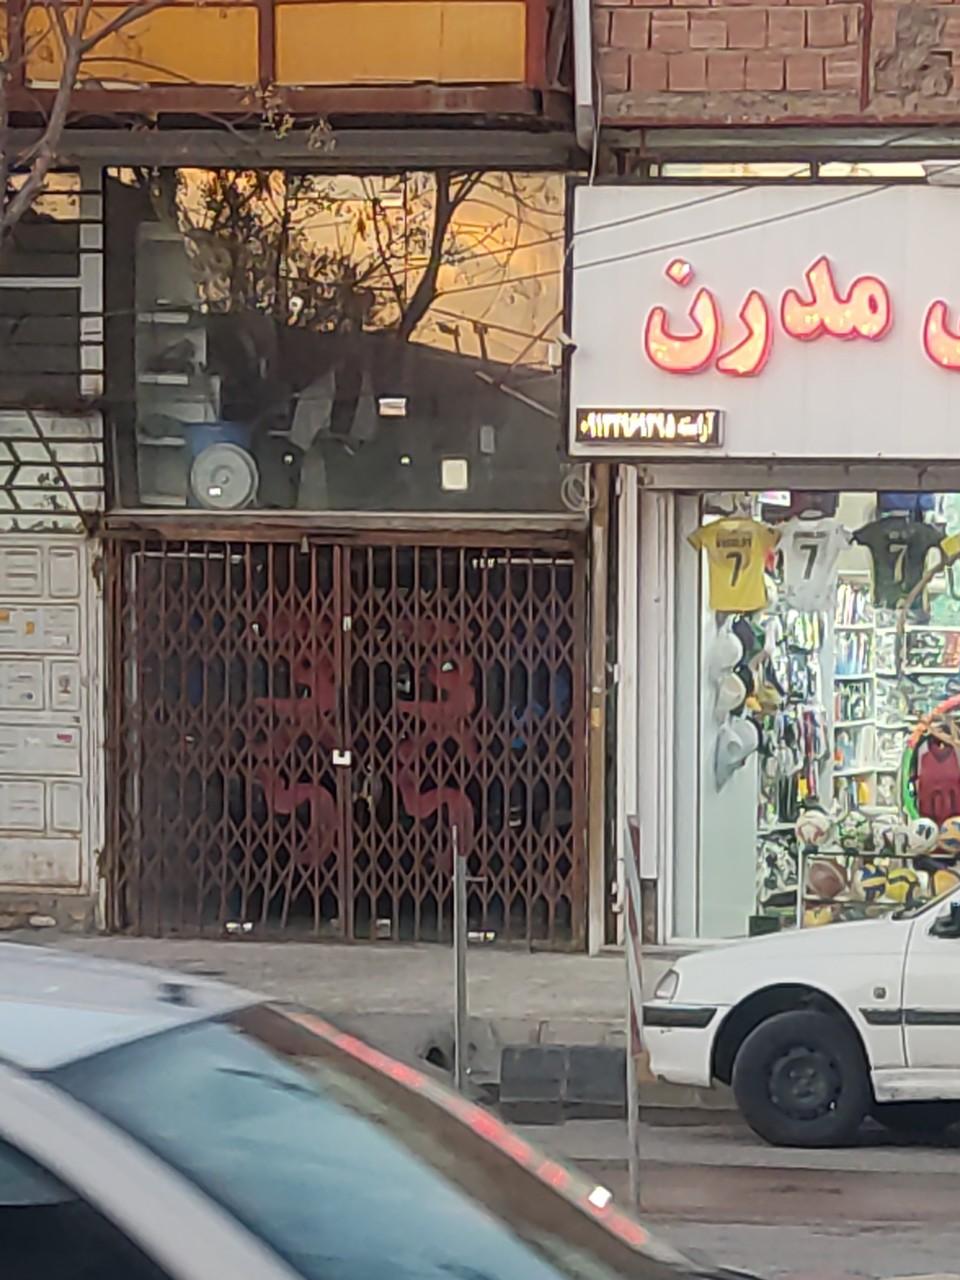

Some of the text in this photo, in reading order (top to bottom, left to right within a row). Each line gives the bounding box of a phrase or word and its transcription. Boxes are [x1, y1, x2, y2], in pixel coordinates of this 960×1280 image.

[644, 255, 893, 377] مدرن
[726, 551, 742, 587] 7
[800, 544, 818, 580] 7
[889, 543, 909, 583] 7
